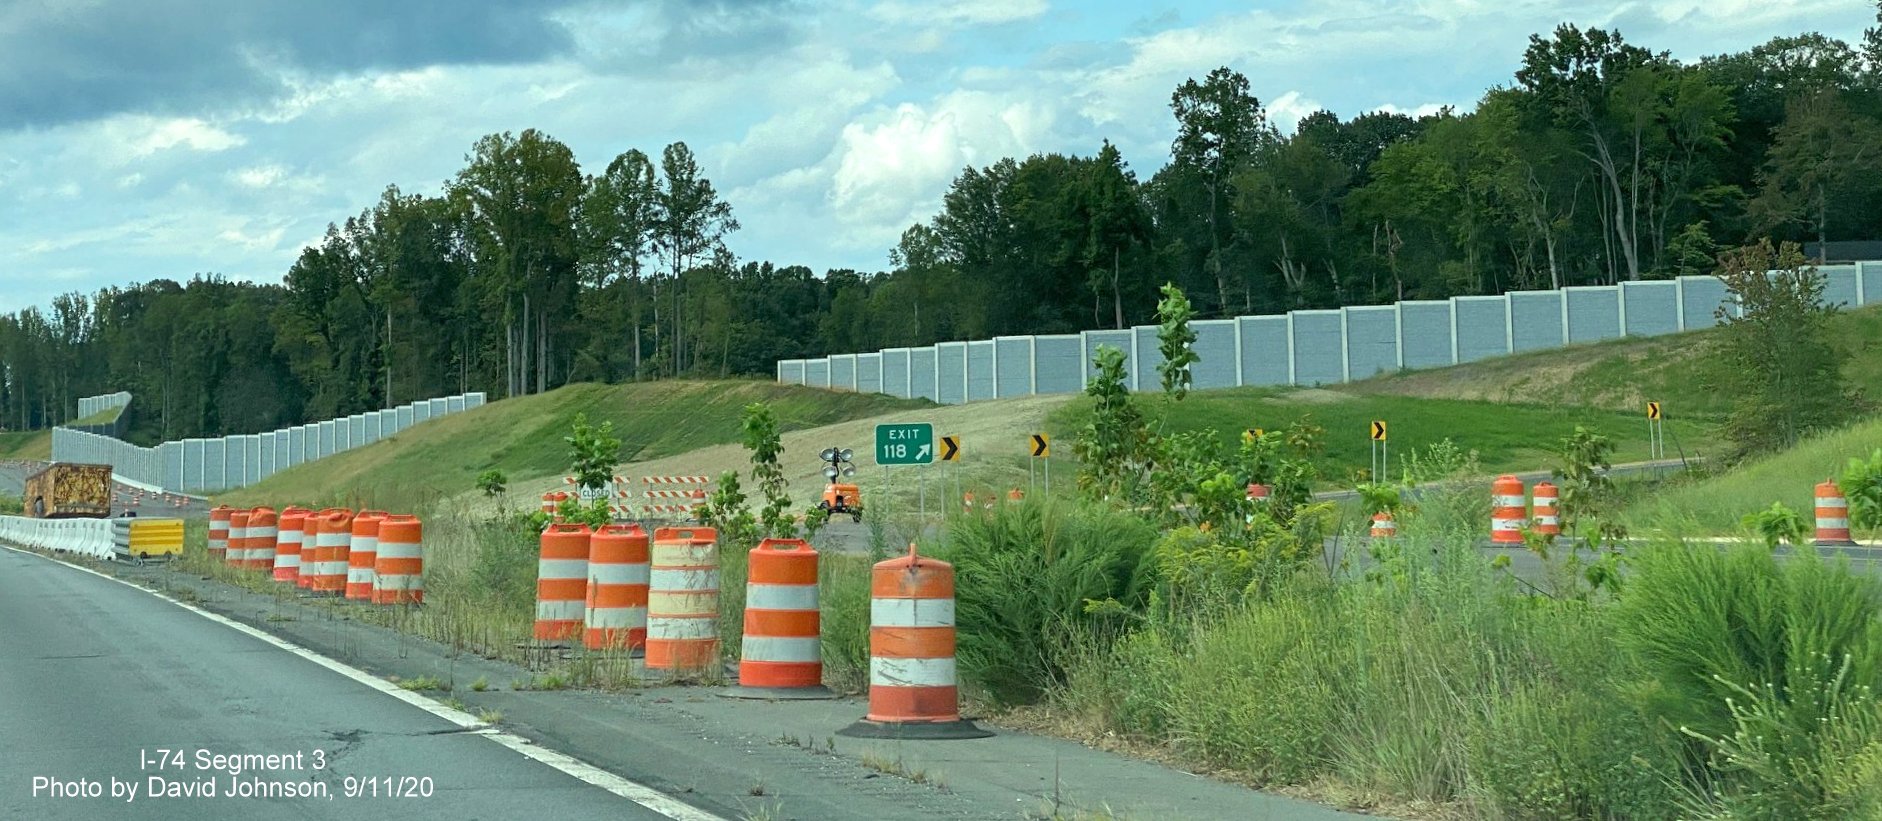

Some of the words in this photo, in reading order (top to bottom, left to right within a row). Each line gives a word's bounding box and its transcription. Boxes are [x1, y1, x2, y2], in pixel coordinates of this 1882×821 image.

[889, 429, 920, 440] EXIT
[884, 444, 907, 459] 118
[582, 489, 611, 497] CLOSED
